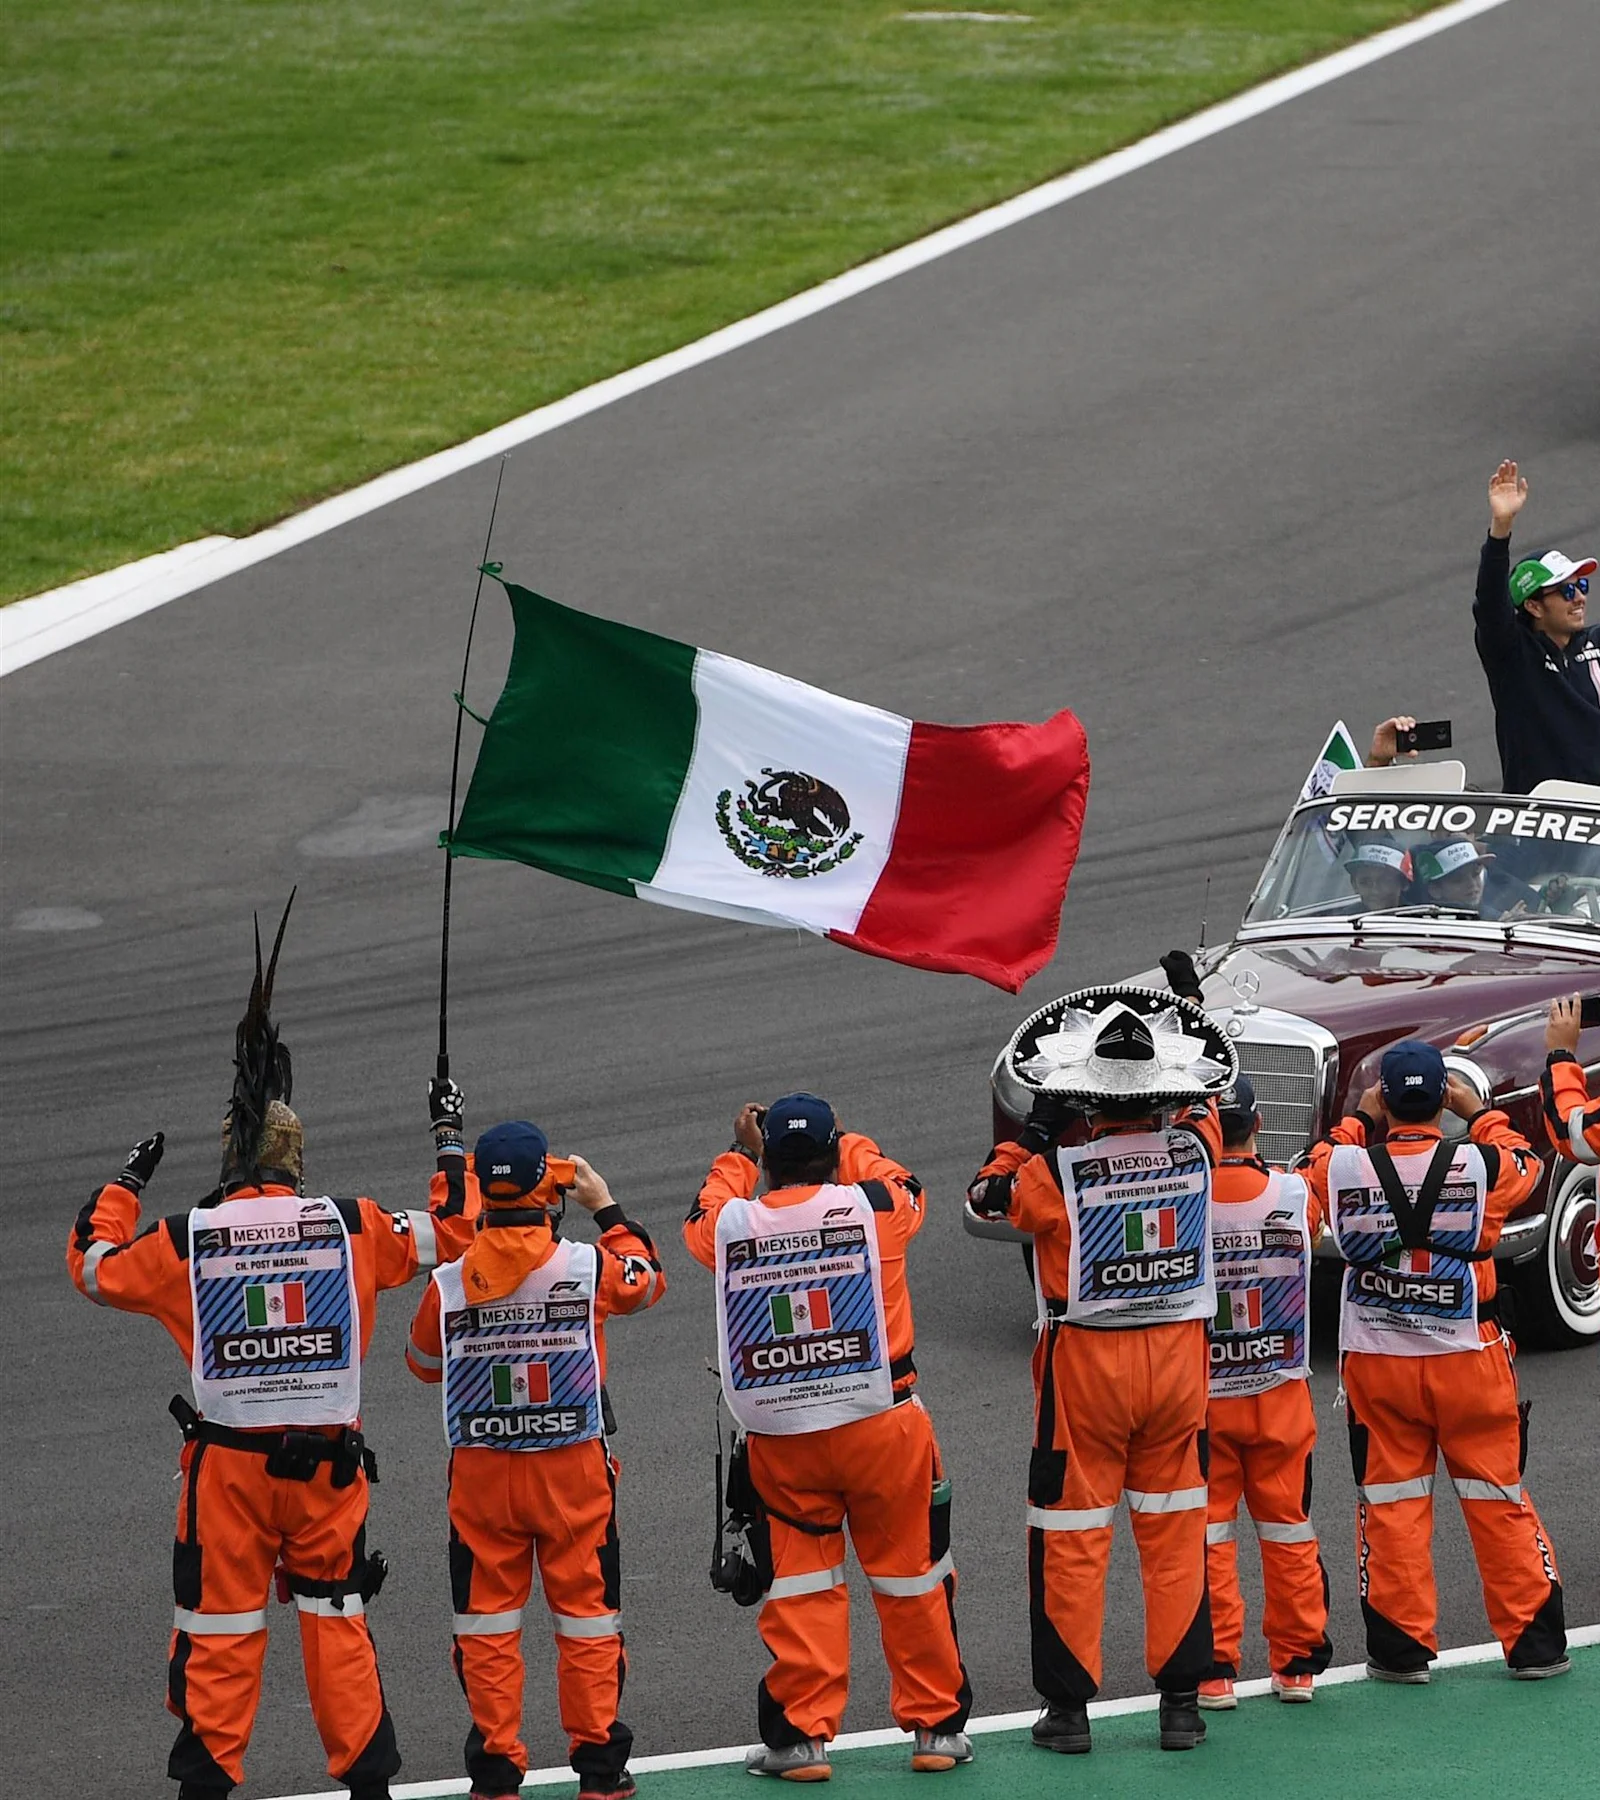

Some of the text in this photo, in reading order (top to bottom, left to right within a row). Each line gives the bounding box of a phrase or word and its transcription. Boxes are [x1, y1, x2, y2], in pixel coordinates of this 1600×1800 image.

[1326, 803, 1477, 833] SERGIO
[1112, 1155, 1168, 1172] MEX1042
[1105, 1180, 1190, 1200] INTERVENTION MARSHAL
[1438, 1186, 1476, 1200] 2018
[234, 1222, 341, 1243] MEX1128 2018
[1377, 1219, 1395, 1230] FLAG
[758, 1228, 863, 1254] MEX1566 2018
[1213, 1233, 1302, 1250] EX1231 2018
[235, 1257, 310, 1271] CH. POST MARSHAL
[741, 1260, 855, 1285] SPECTATOR CONTROL MARSHAL
[1101, 1254, 1195, 1286] COURSE
[1228, 1265, 1259, 1277] MARSHAL
[1361, 1270, 1455, 1304] COURSE
[482, 1302, 588, 1325] MEX1527 2018
[223, 1332, 333, 1362] COURSE
[463, 1336, 578, 1354] SPECTATOR CONTROL MARSHAL
[751, 1336, 861, 1371] COURSE
[1209, 1335, 1284, 1363] OURSE
[222, 1387, 247, 1397] GRAN
[247, 1385, 278, 1395] PREMIO
[279, 1384, 289, 1393] DE
[259, 1378, 299, 1387] FORMULA
[789, 1383, 829, 1394] FORMULA
[755, 1396, 778, 1407] GRAN
[778, 1393, 809, 1404] PREMIO
[469, 1411, 577, 1438] COURSE
